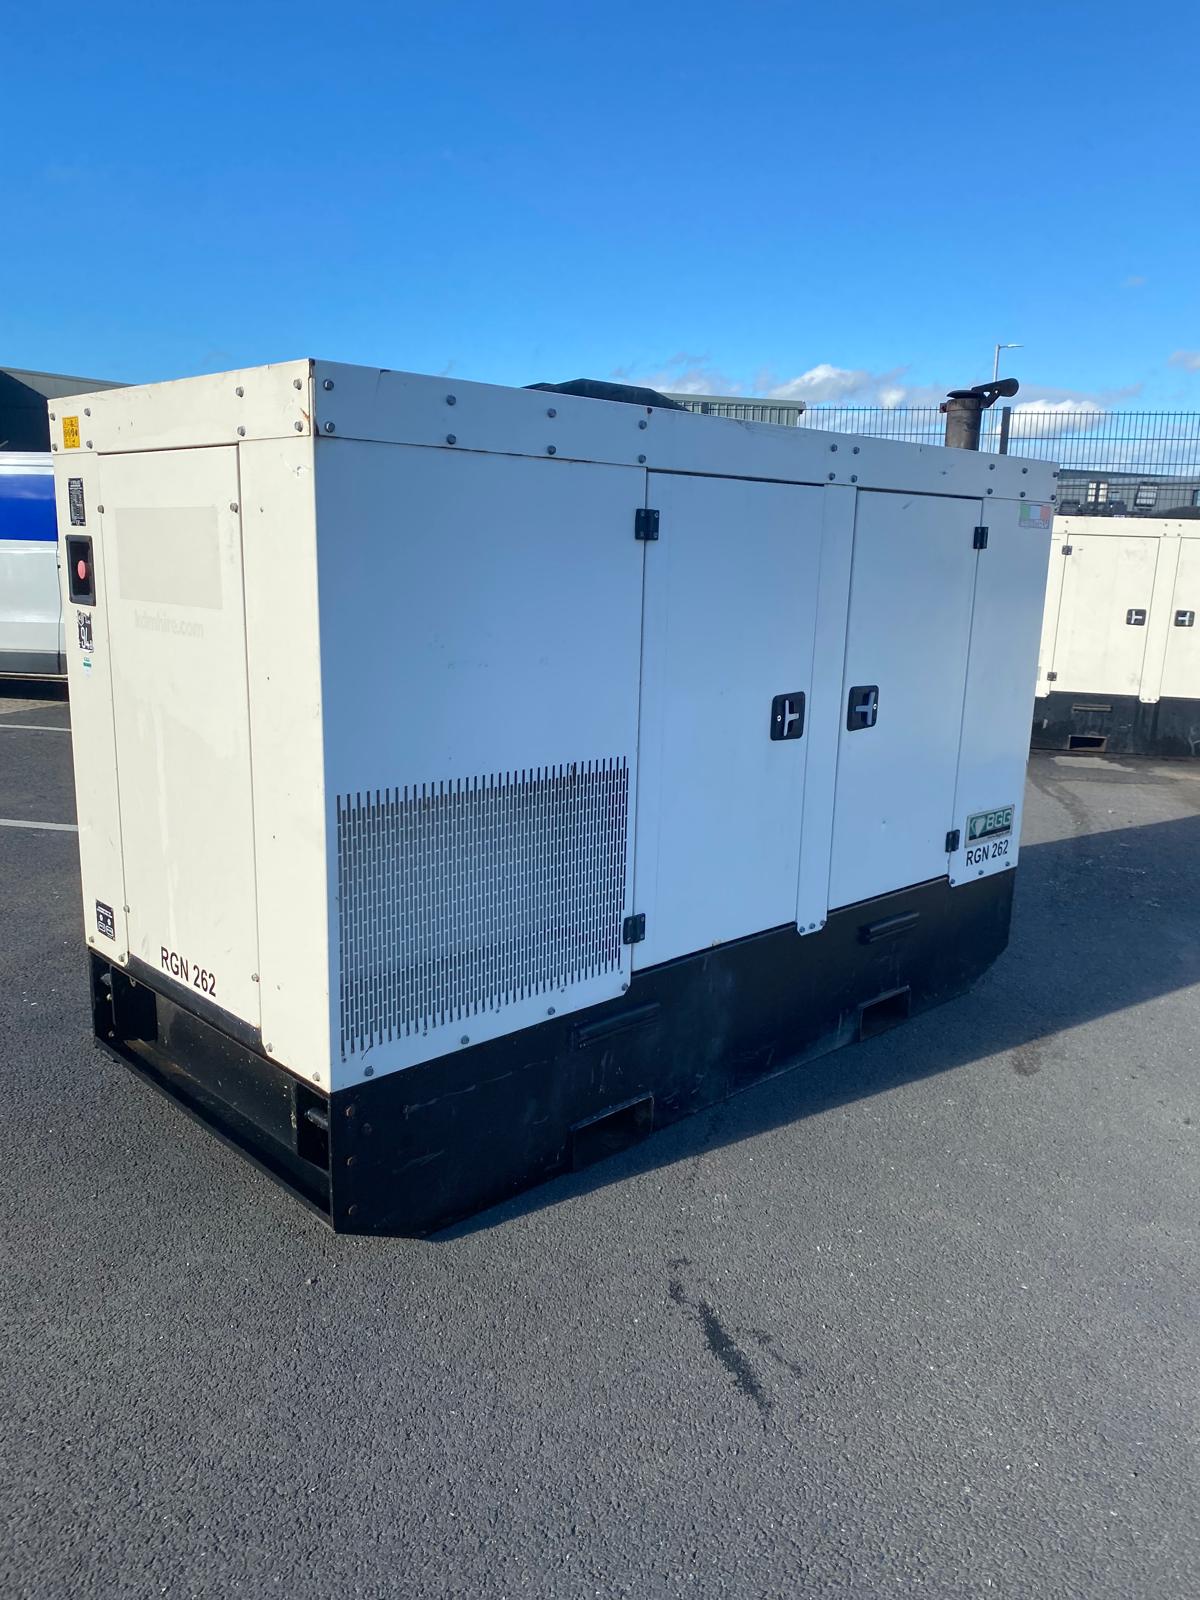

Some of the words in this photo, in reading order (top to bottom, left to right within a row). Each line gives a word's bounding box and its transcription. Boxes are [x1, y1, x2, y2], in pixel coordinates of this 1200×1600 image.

[986, 809, 1012, 831] BGG
[966, 844, 990, 867] RGN
[991, 839, 1009, 859] 262
[160, 945, 189, 982] RGN
[193, 964, 217, 998] 262
